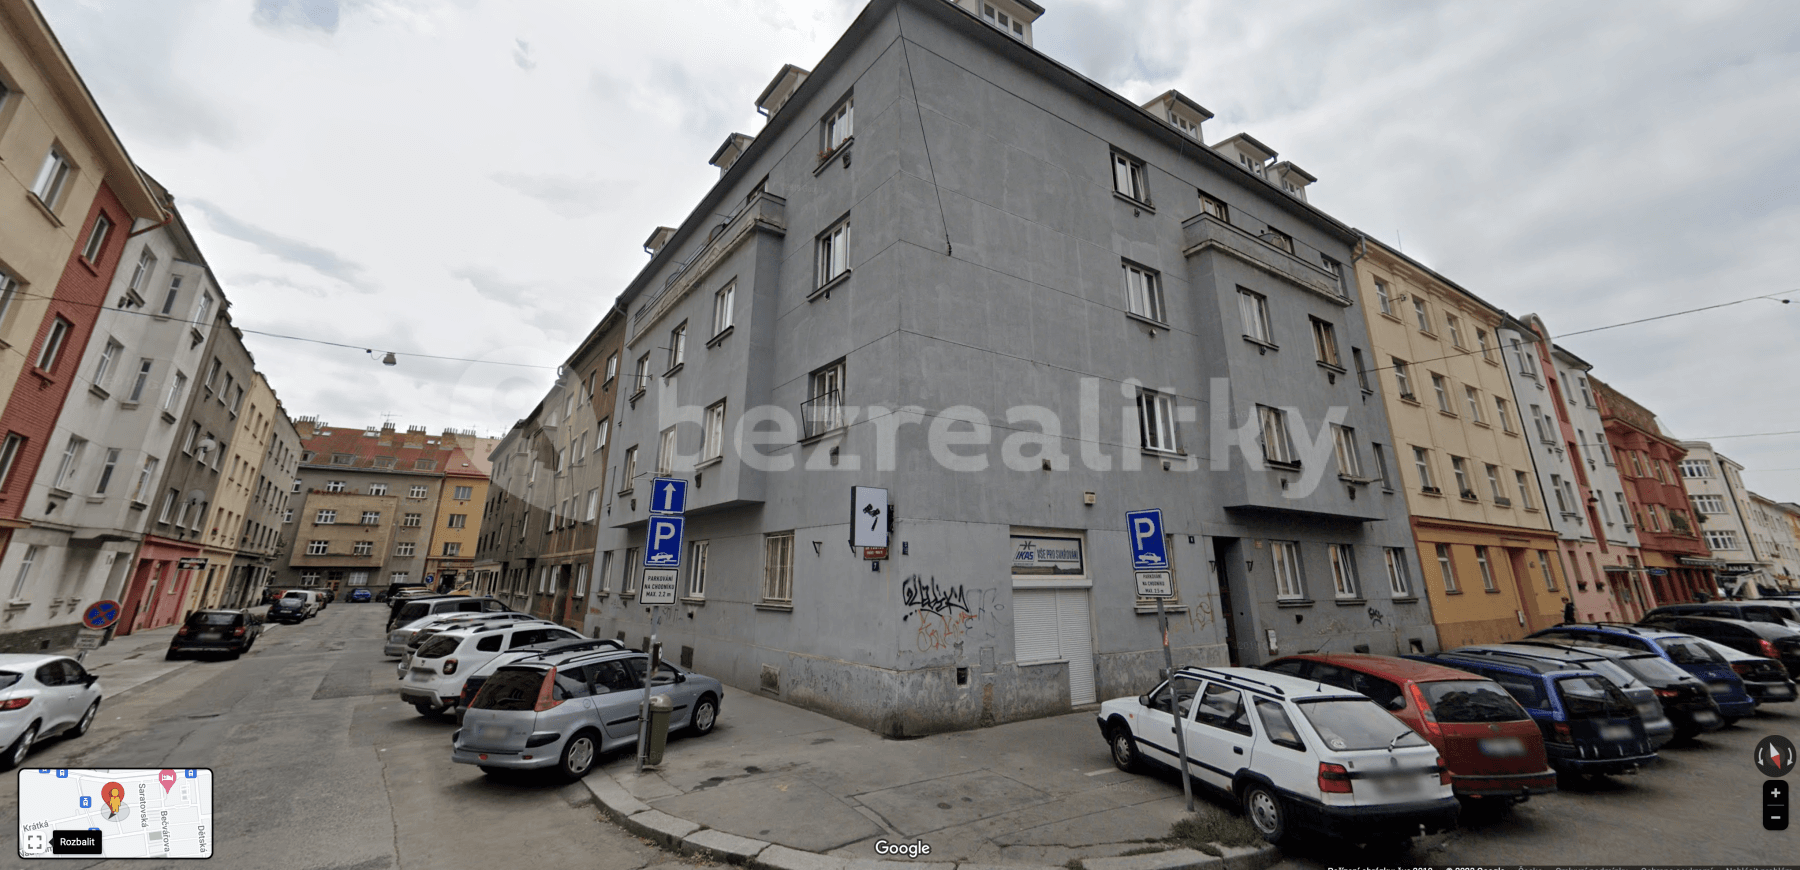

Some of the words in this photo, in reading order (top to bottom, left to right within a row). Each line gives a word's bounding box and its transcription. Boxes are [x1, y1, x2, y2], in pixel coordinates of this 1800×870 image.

[654, 522, 676, 550] P
[1134, 517, 1155, 551] P
[647, 574, 674, 582] PARKOVÁNÍ
[652, 582, 675, 590] CHODNÍKU
